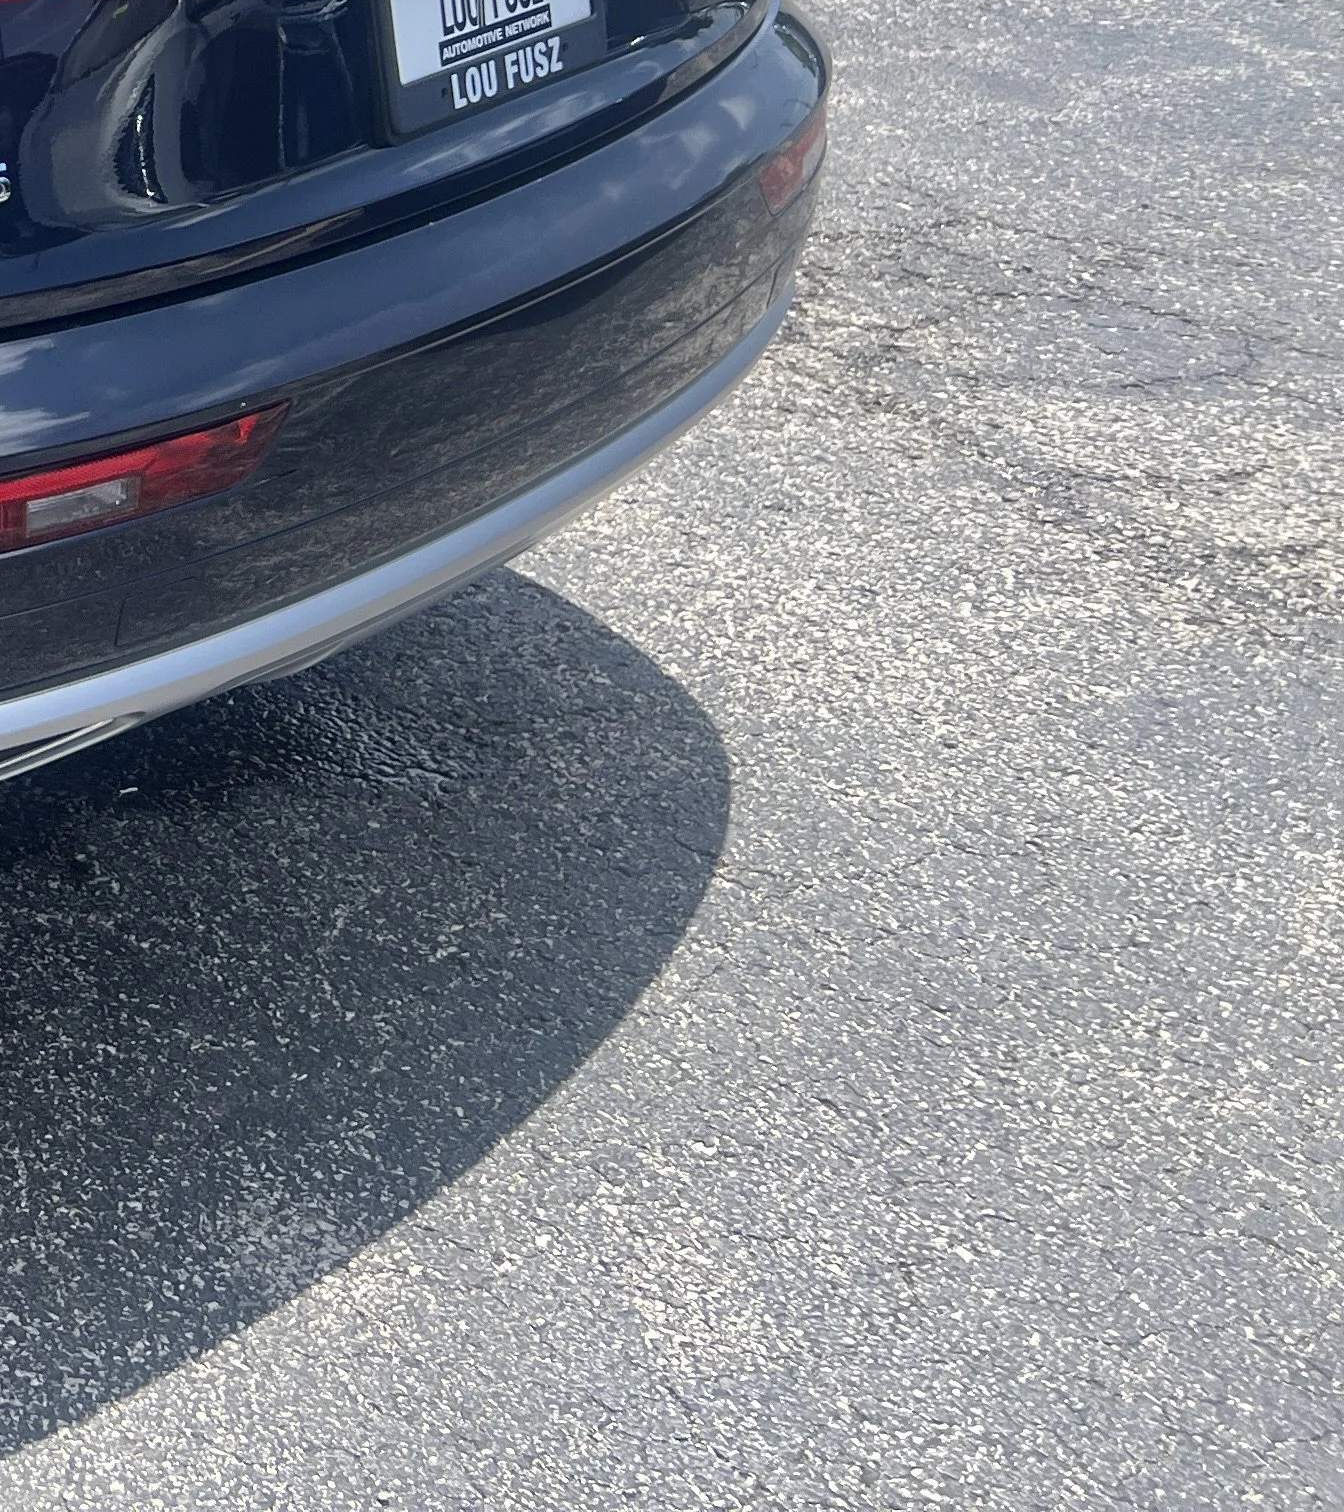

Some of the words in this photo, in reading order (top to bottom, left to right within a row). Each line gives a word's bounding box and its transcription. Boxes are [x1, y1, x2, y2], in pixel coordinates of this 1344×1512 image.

[442, 30, 504, 61] AUTOMOTIVE
[505, 11, 550, 37] NETWORK
[451, 60, 498, 110] LOU
[504, 36, 563, 89] FUSZ
